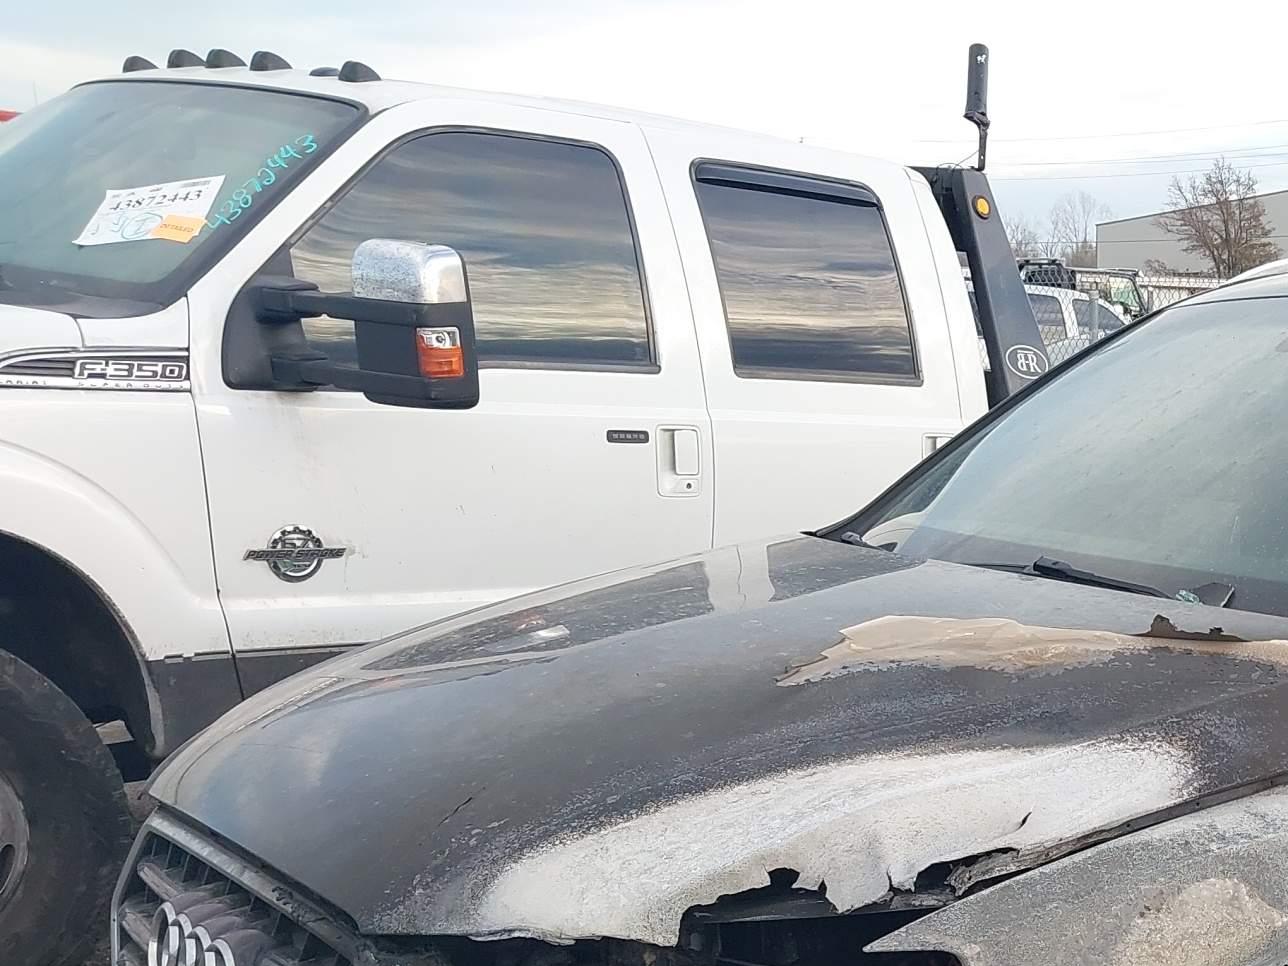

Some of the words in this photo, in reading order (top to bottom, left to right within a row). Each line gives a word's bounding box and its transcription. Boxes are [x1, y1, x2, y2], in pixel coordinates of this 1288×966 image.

[207, 134, 317, 229] 43872443
[109, 189, 203, 212] 43872443
[74, 359, 187, 381] F-350
[243, 549, 294, 560] POWER
[295, 548, 346, 560] STROKE
